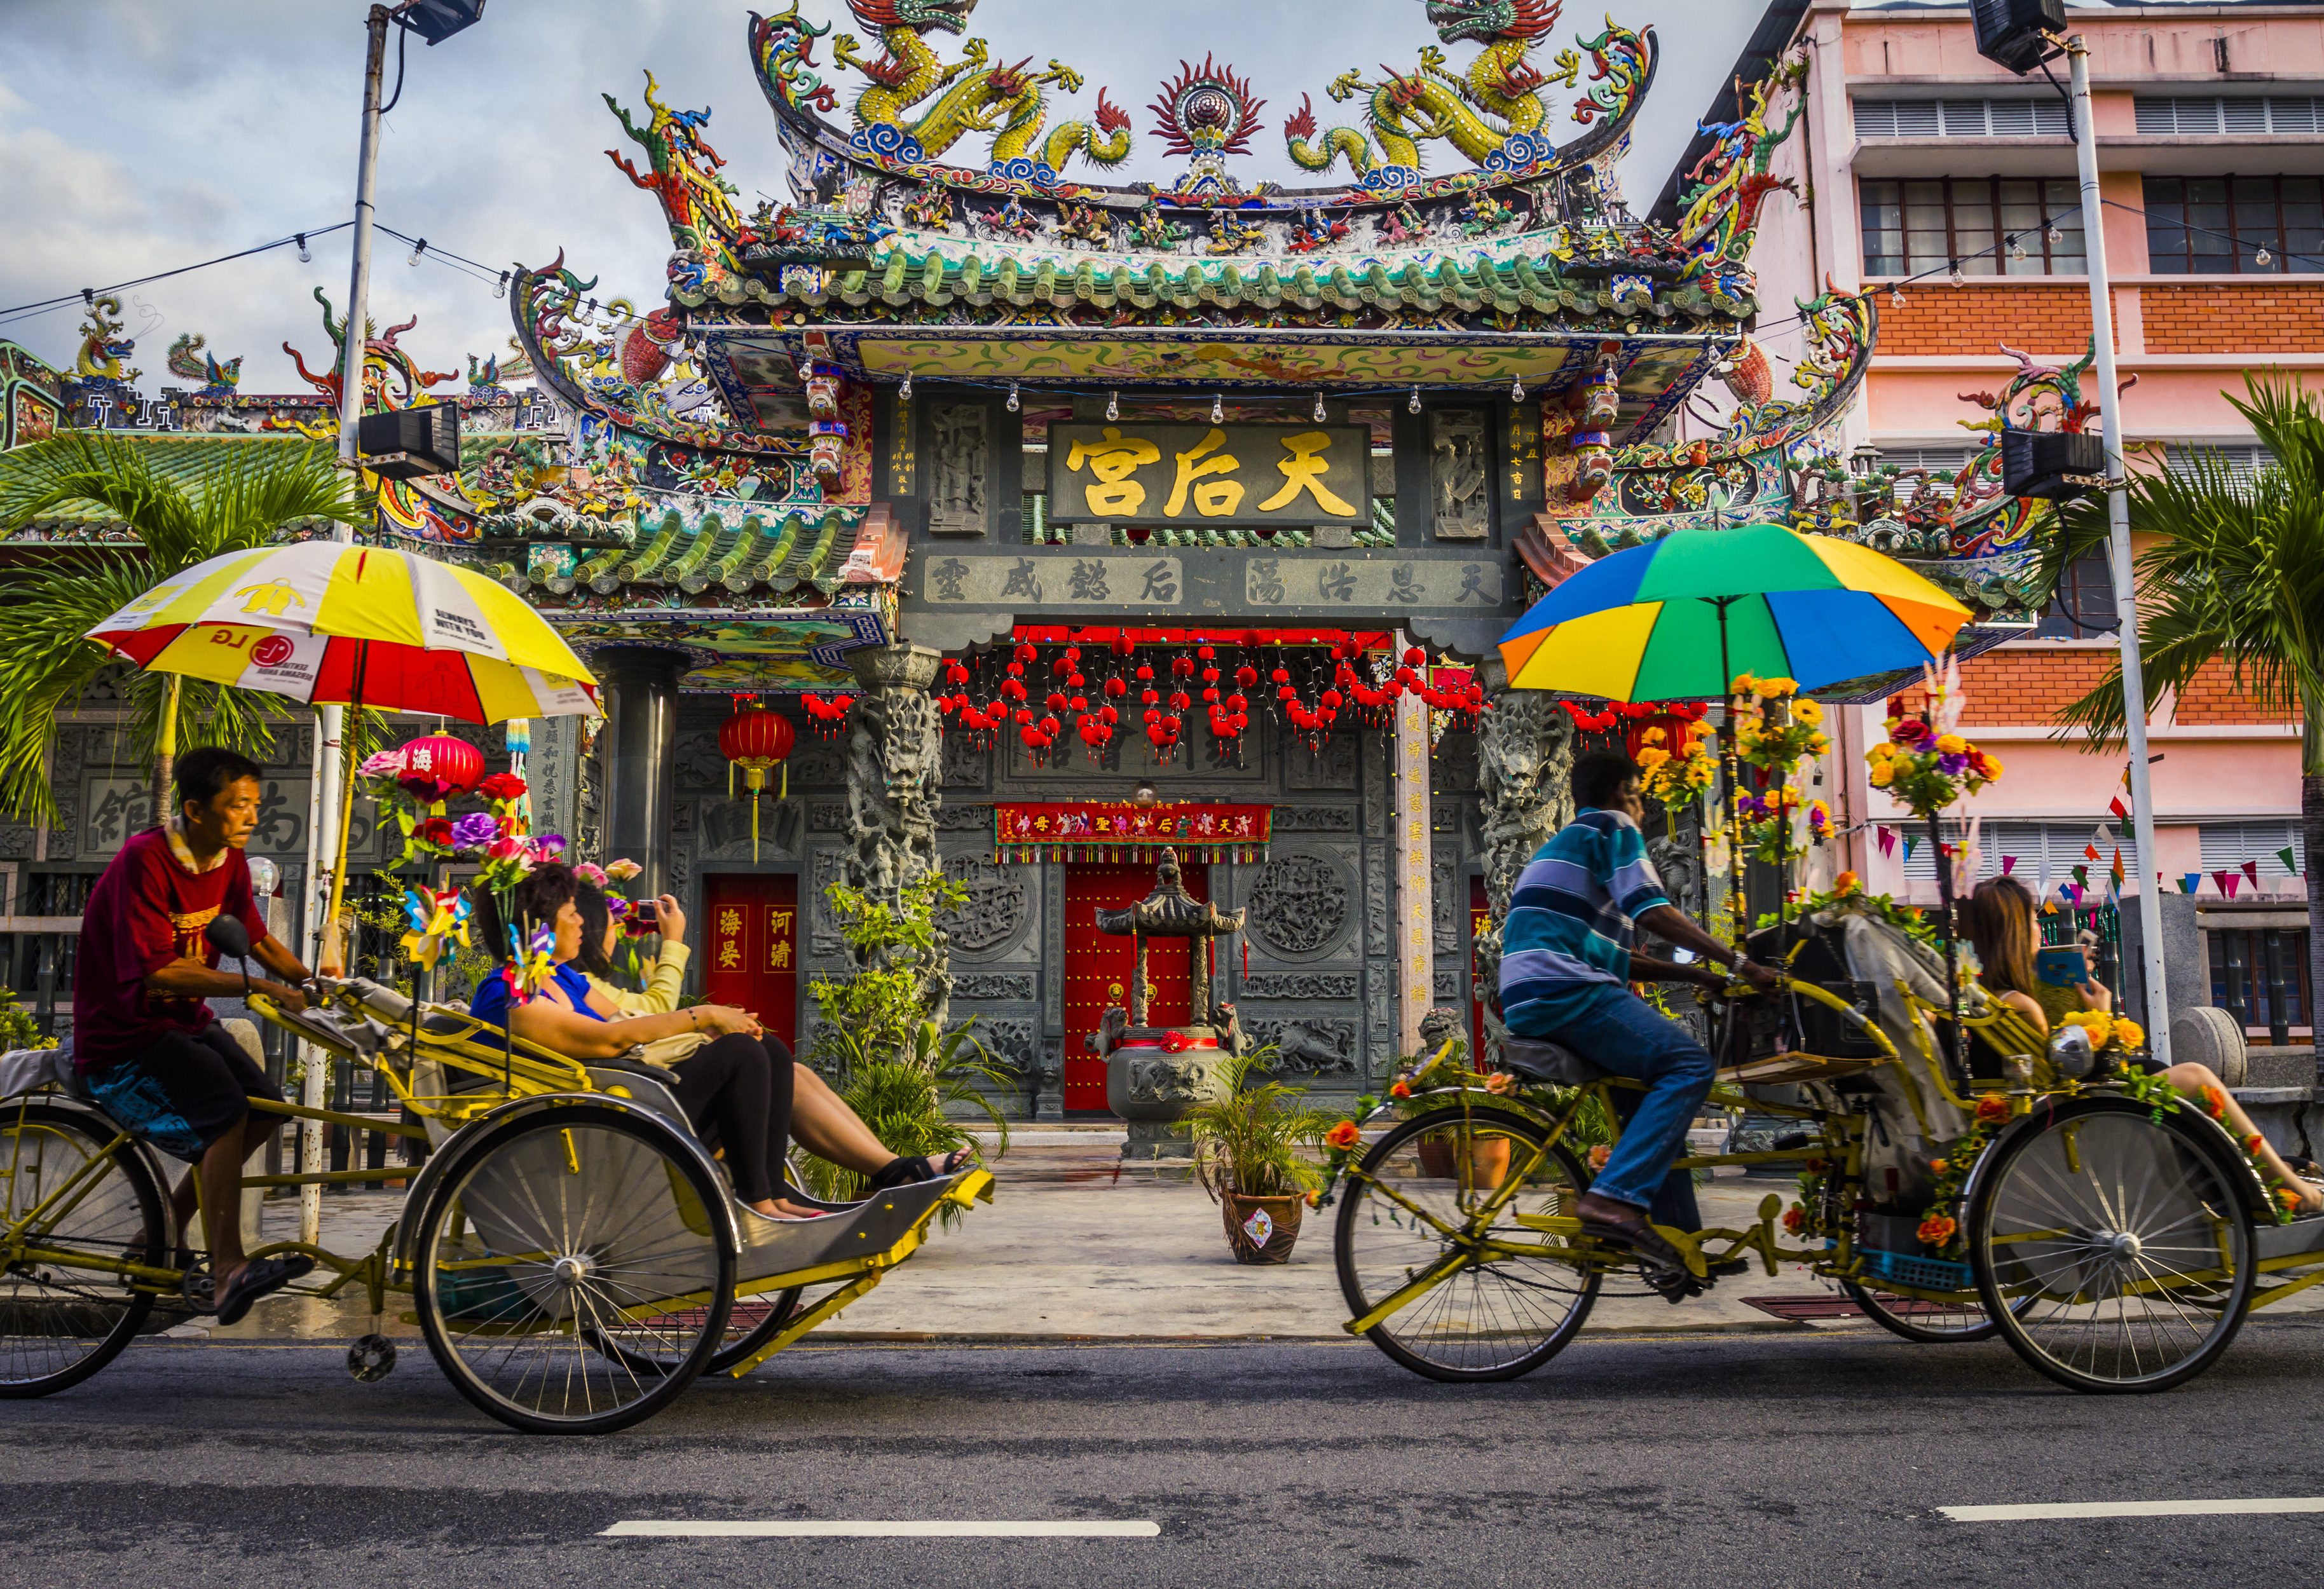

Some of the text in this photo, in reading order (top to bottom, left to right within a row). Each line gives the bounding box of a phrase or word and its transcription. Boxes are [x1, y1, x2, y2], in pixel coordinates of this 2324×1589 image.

[1066, 426, 1357, 517] 天后宮
[1510, 408, 1524, 500] 正月廿七吉日
[1526, 432, 1539, 458] 丁丑
[463, 625, 486, 640] YOU
[1034, 815, 1233, 833] 天后聖母
[718, 908, 742, 968] 海晏
[770, 911, 793, 968] 河清
